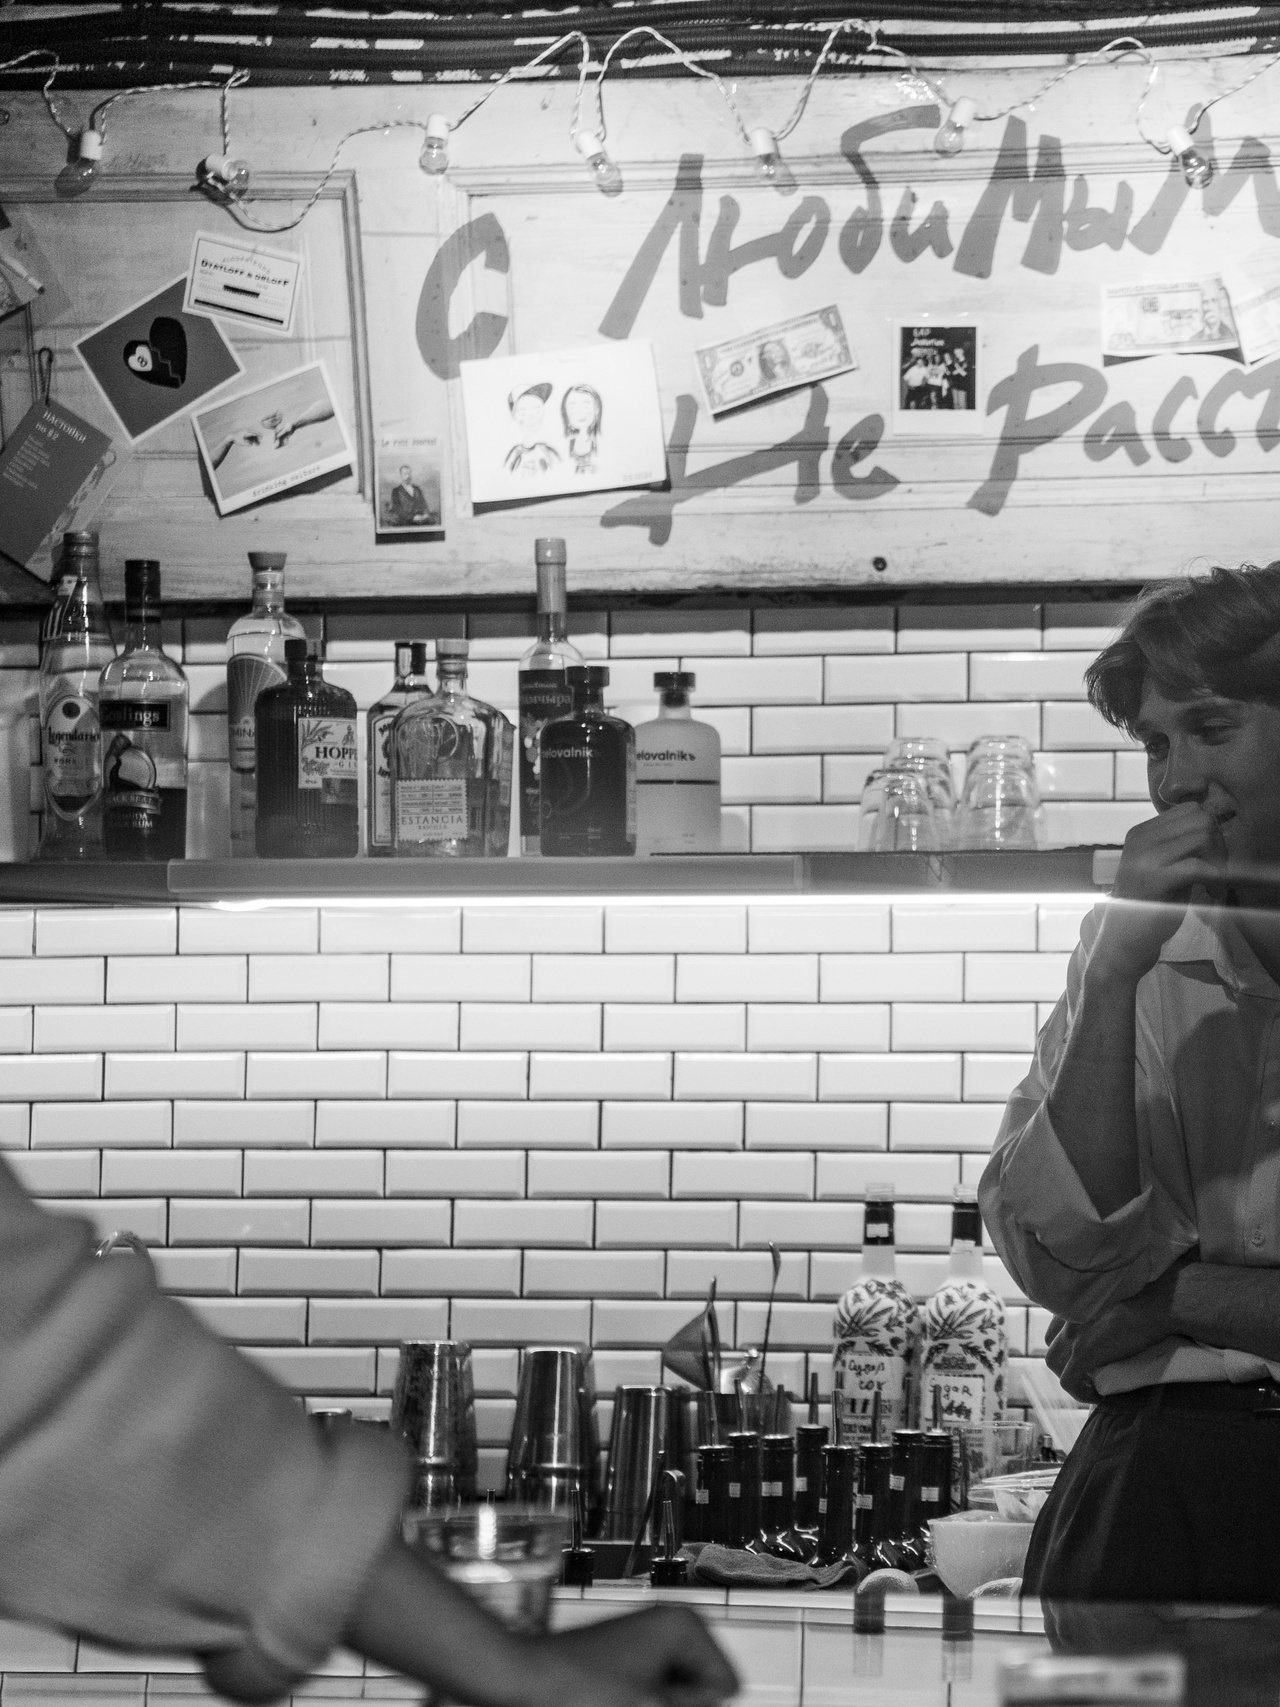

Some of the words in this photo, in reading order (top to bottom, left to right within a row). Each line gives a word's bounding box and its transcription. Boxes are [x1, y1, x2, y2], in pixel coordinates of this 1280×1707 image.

[415, 211, 511, 380] С
[42, 410, 87, 444] НАСТОЙКИ
[48, 726, 100, 746] Legendario
[401, 815, 464, 826] ESTANCIA
